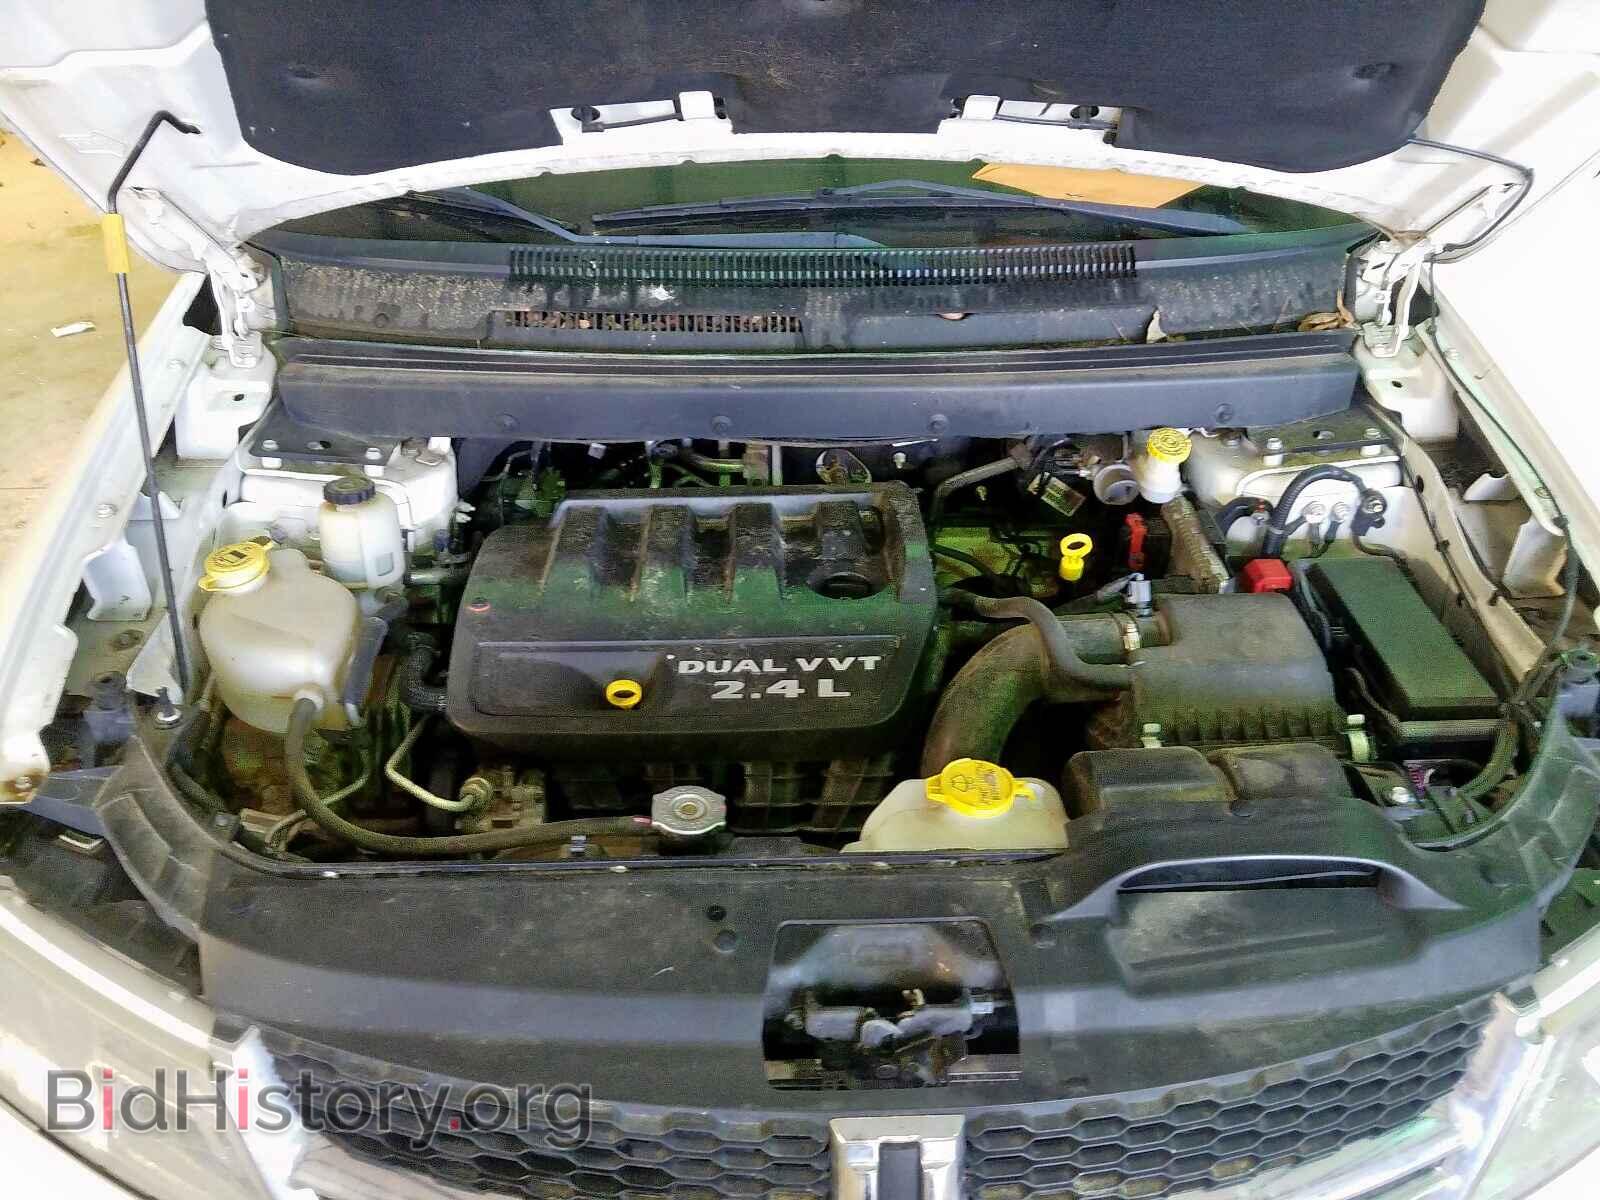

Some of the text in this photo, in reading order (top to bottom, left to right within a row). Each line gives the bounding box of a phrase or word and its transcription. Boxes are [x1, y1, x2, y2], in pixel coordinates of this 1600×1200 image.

[678, 656, 881, 674] DUAL VVT
[711, 678, 851, 699] 2.4 L
